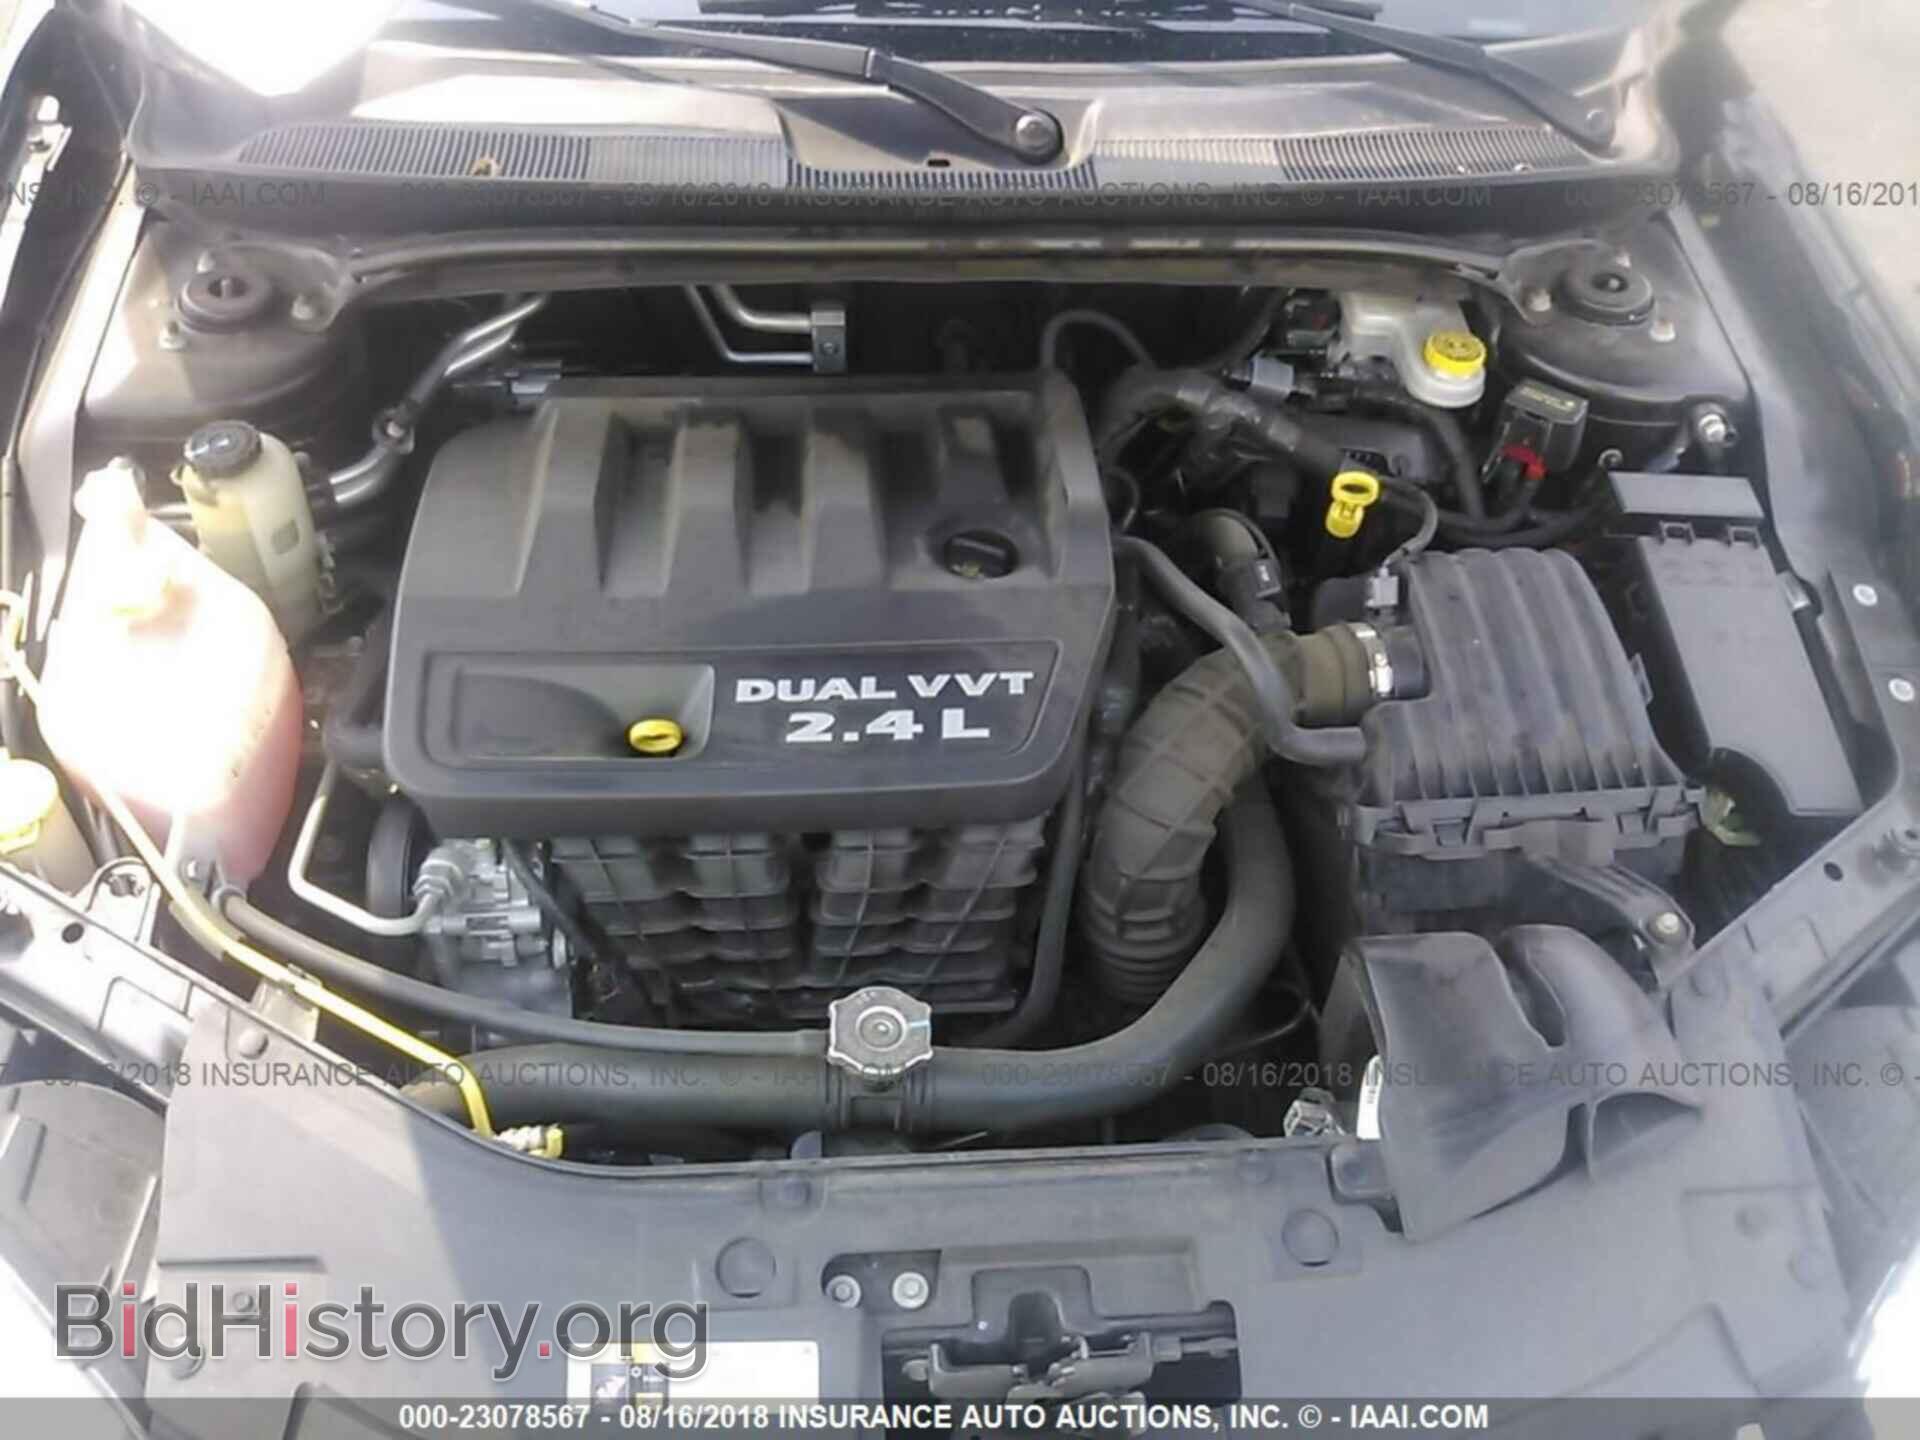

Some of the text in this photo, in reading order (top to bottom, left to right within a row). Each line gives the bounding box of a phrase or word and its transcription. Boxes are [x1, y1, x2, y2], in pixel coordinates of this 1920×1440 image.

[735, 671, 1034, 702] DUAL VVT
[785, 708, 990, 743] 2.4 L
